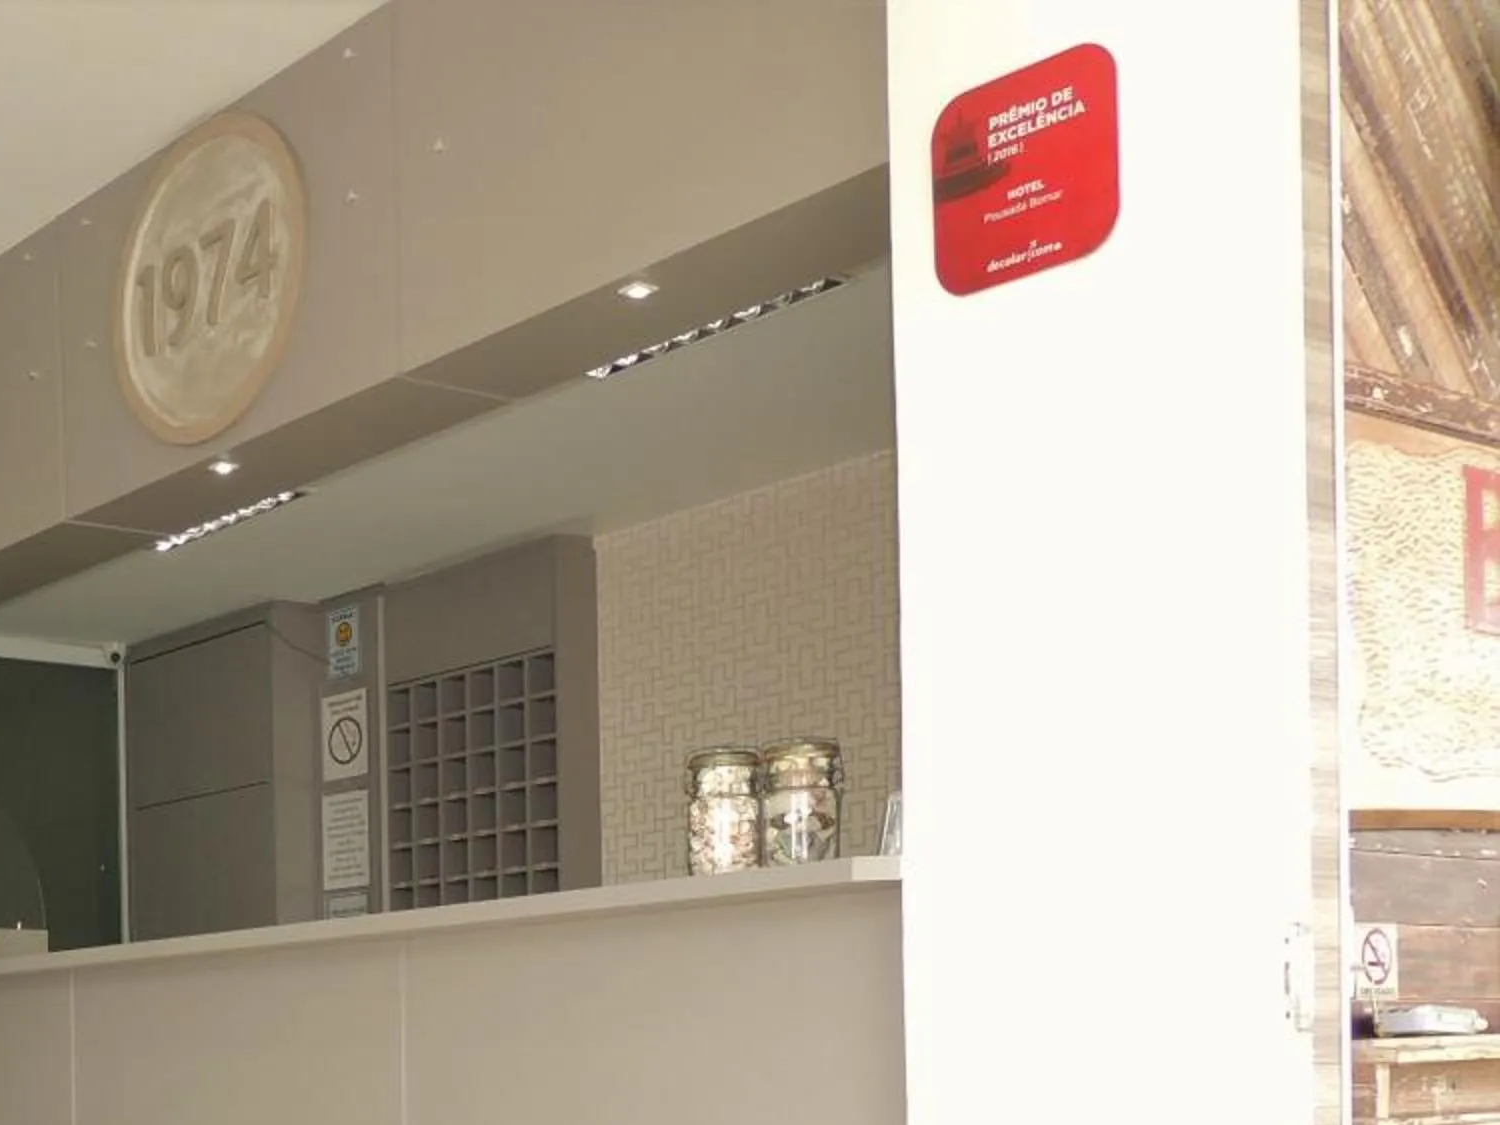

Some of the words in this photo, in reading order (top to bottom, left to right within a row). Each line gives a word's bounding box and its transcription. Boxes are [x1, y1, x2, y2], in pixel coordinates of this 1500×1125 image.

[1051, 86, 1074, 107] DE
[987, 100, 1085, 148] EXCELÊNCIA
[1007, 179, 1045, 201] HOTEL
[136, 197, 278, 358] 1974
